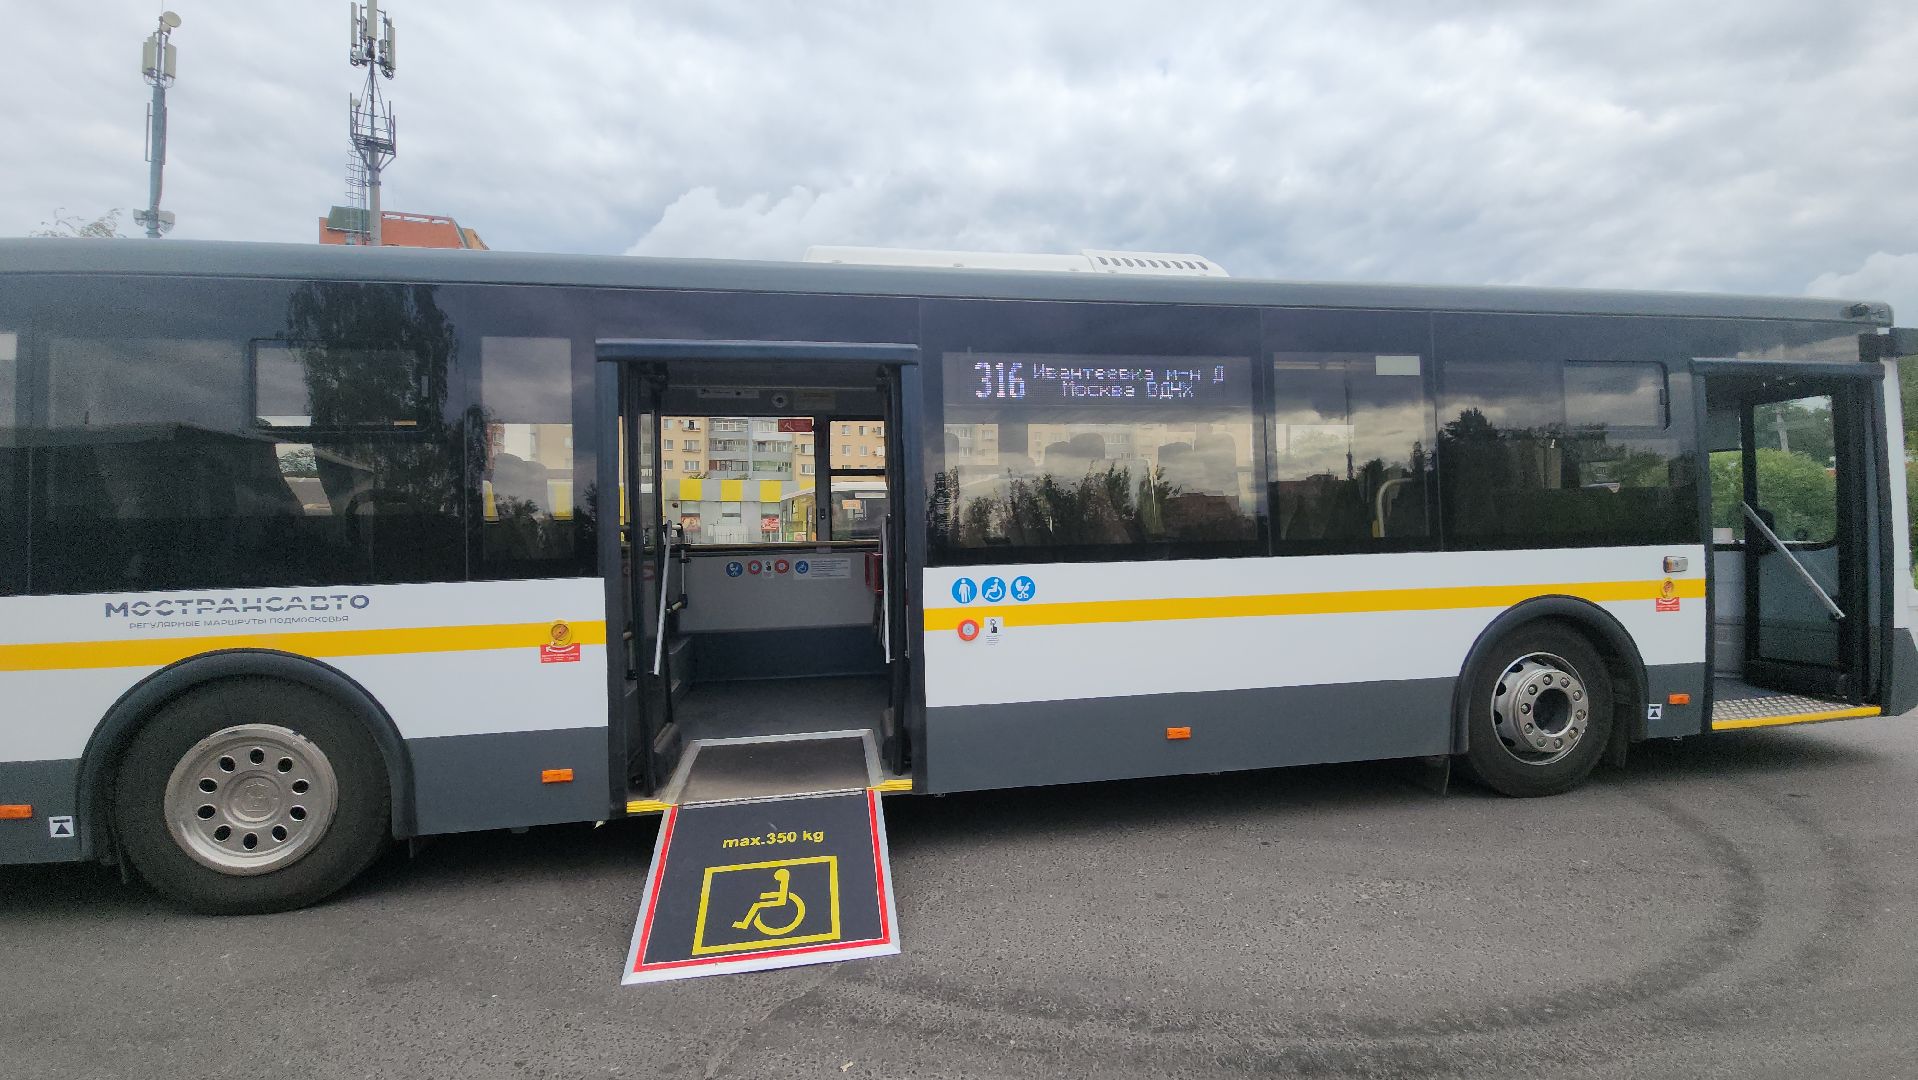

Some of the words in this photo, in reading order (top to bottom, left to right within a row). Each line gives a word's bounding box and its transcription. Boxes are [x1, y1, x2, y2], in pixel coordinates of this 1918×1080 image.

[973, 362, 1026, 398] 316
[1166, 369, 1201, 381] м-н
[1062, 380, 1135, 397] Москва
[105, 594, 369, 618] МОСТРАНСАВТО
[129, 620, 200, 630] РЕГУЛЯРНЫЕ
[203, 617, 267, 627] МАРШРУТЫ
[269, 615, 349, 625] ПОДМОСКОВЬЯ
[802, 830, 824, 843] kg
